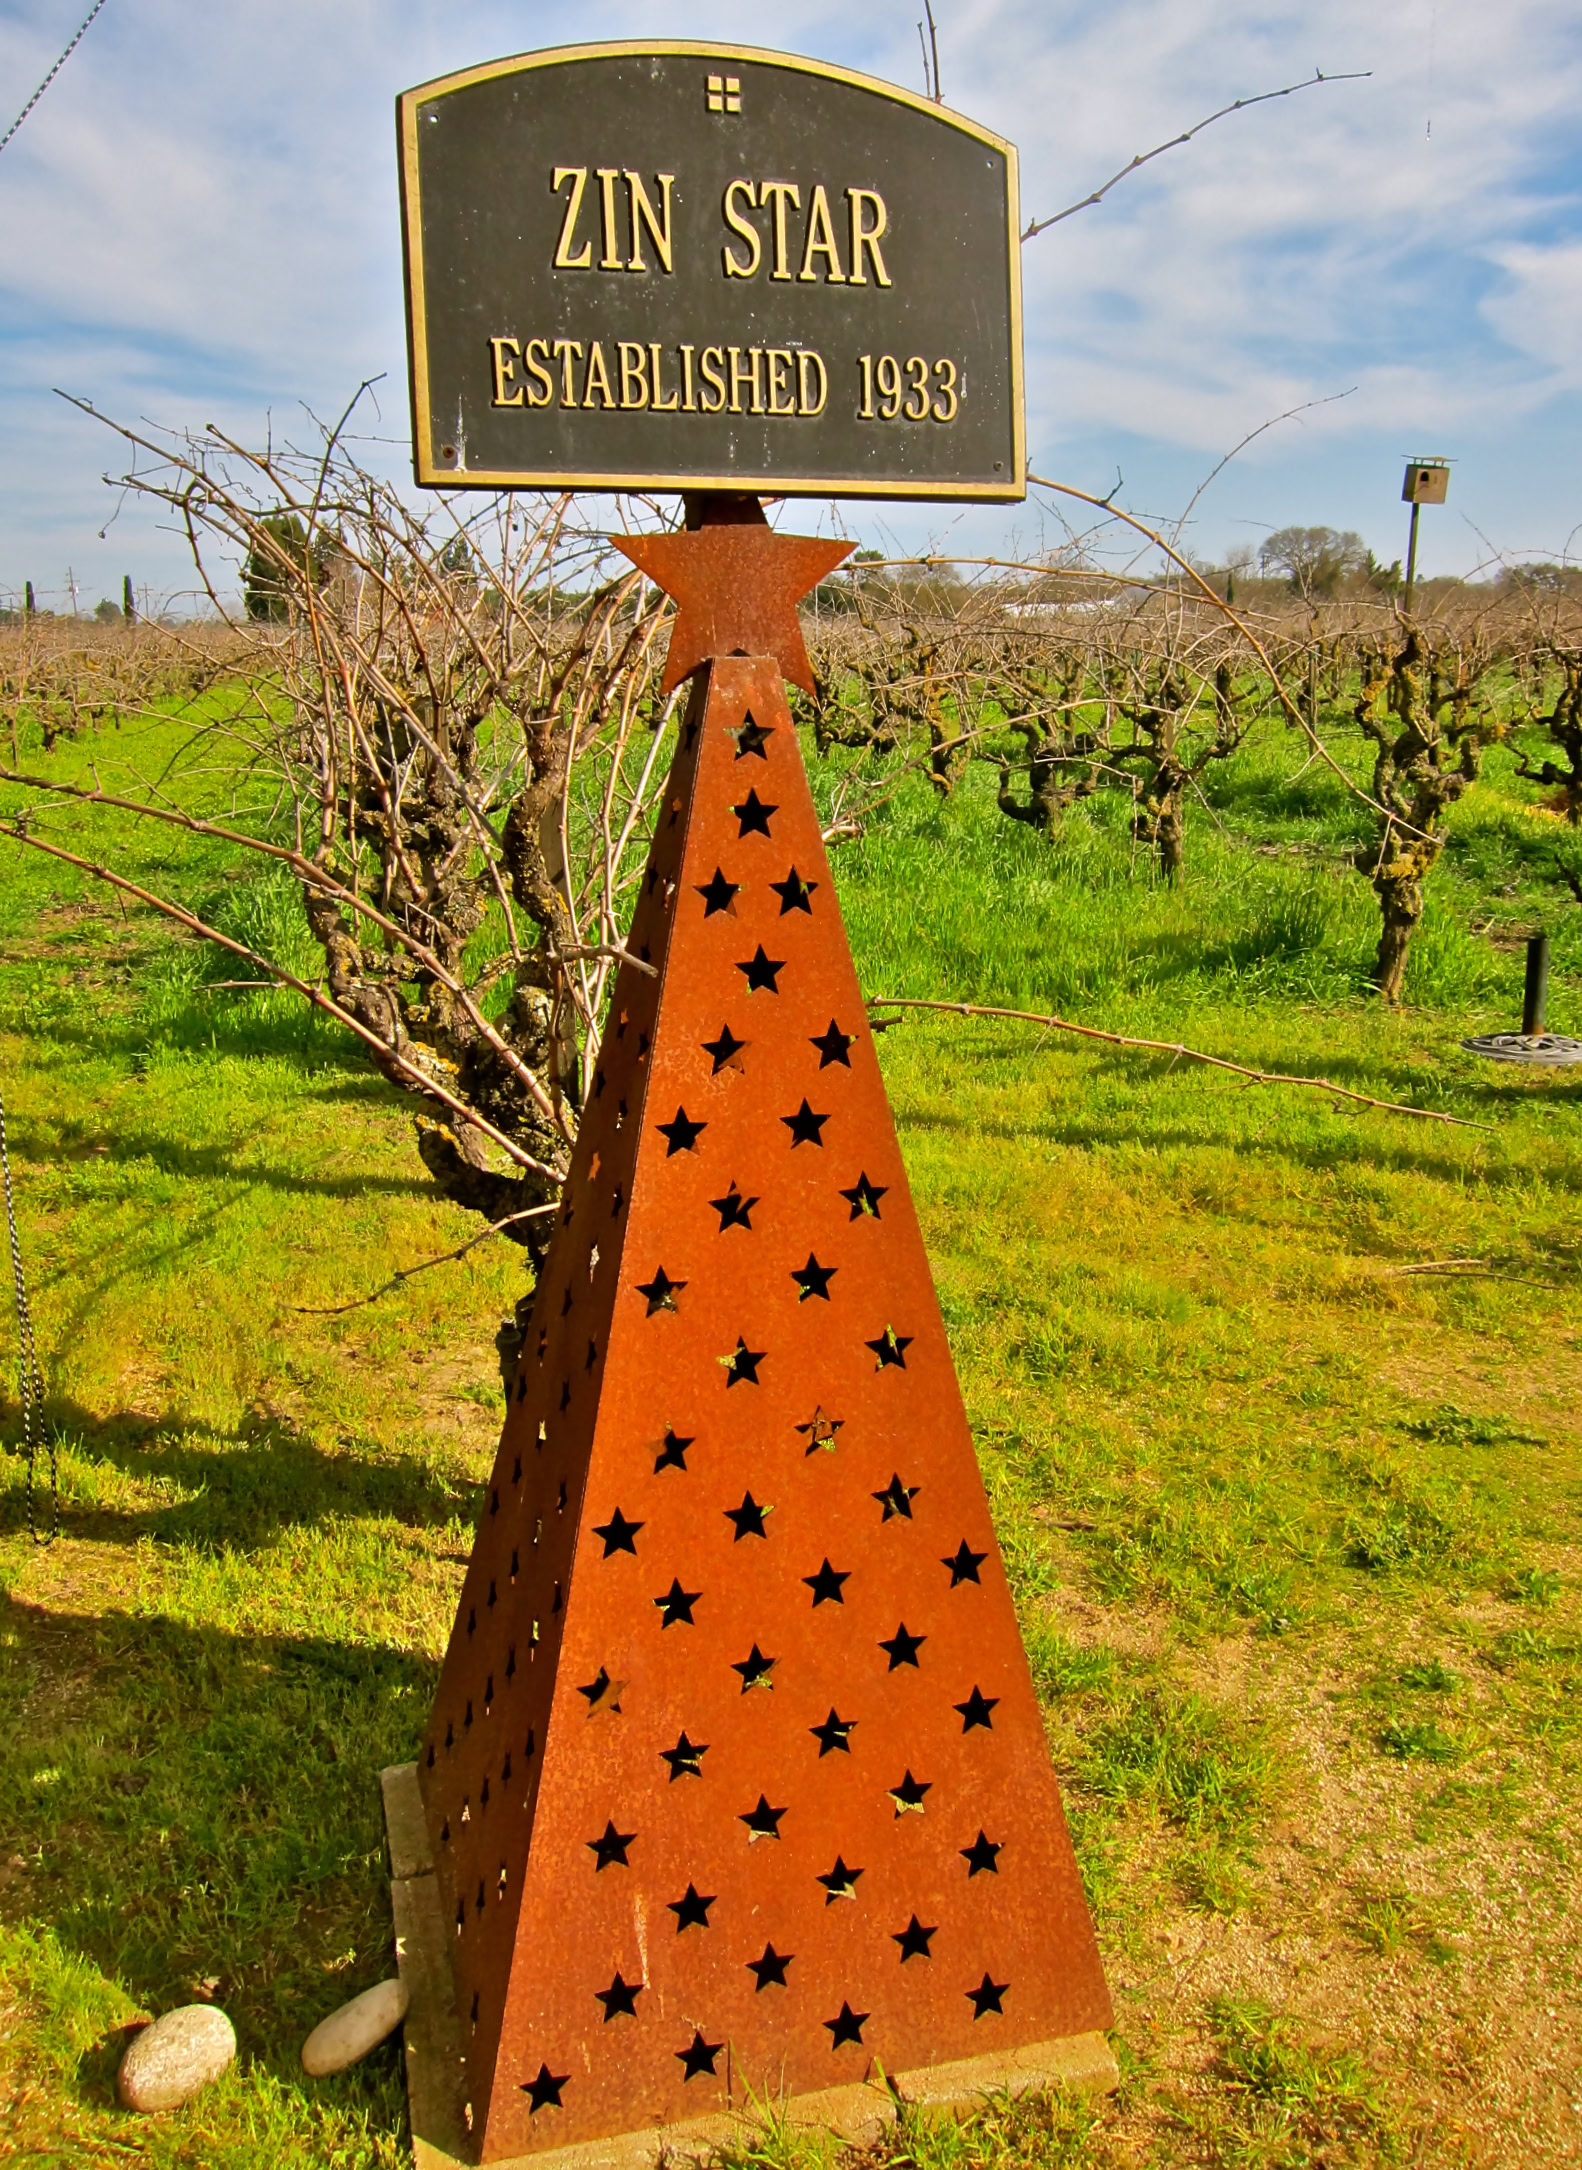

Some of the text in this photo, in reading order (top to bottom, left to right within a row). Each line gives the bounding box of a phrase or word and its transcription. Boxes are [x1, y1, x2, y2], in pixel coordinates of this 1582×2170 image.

[552, 167, 893, 287] ZIN STAR
[490, 337, 958, 422] ESTABLISHED 1933
